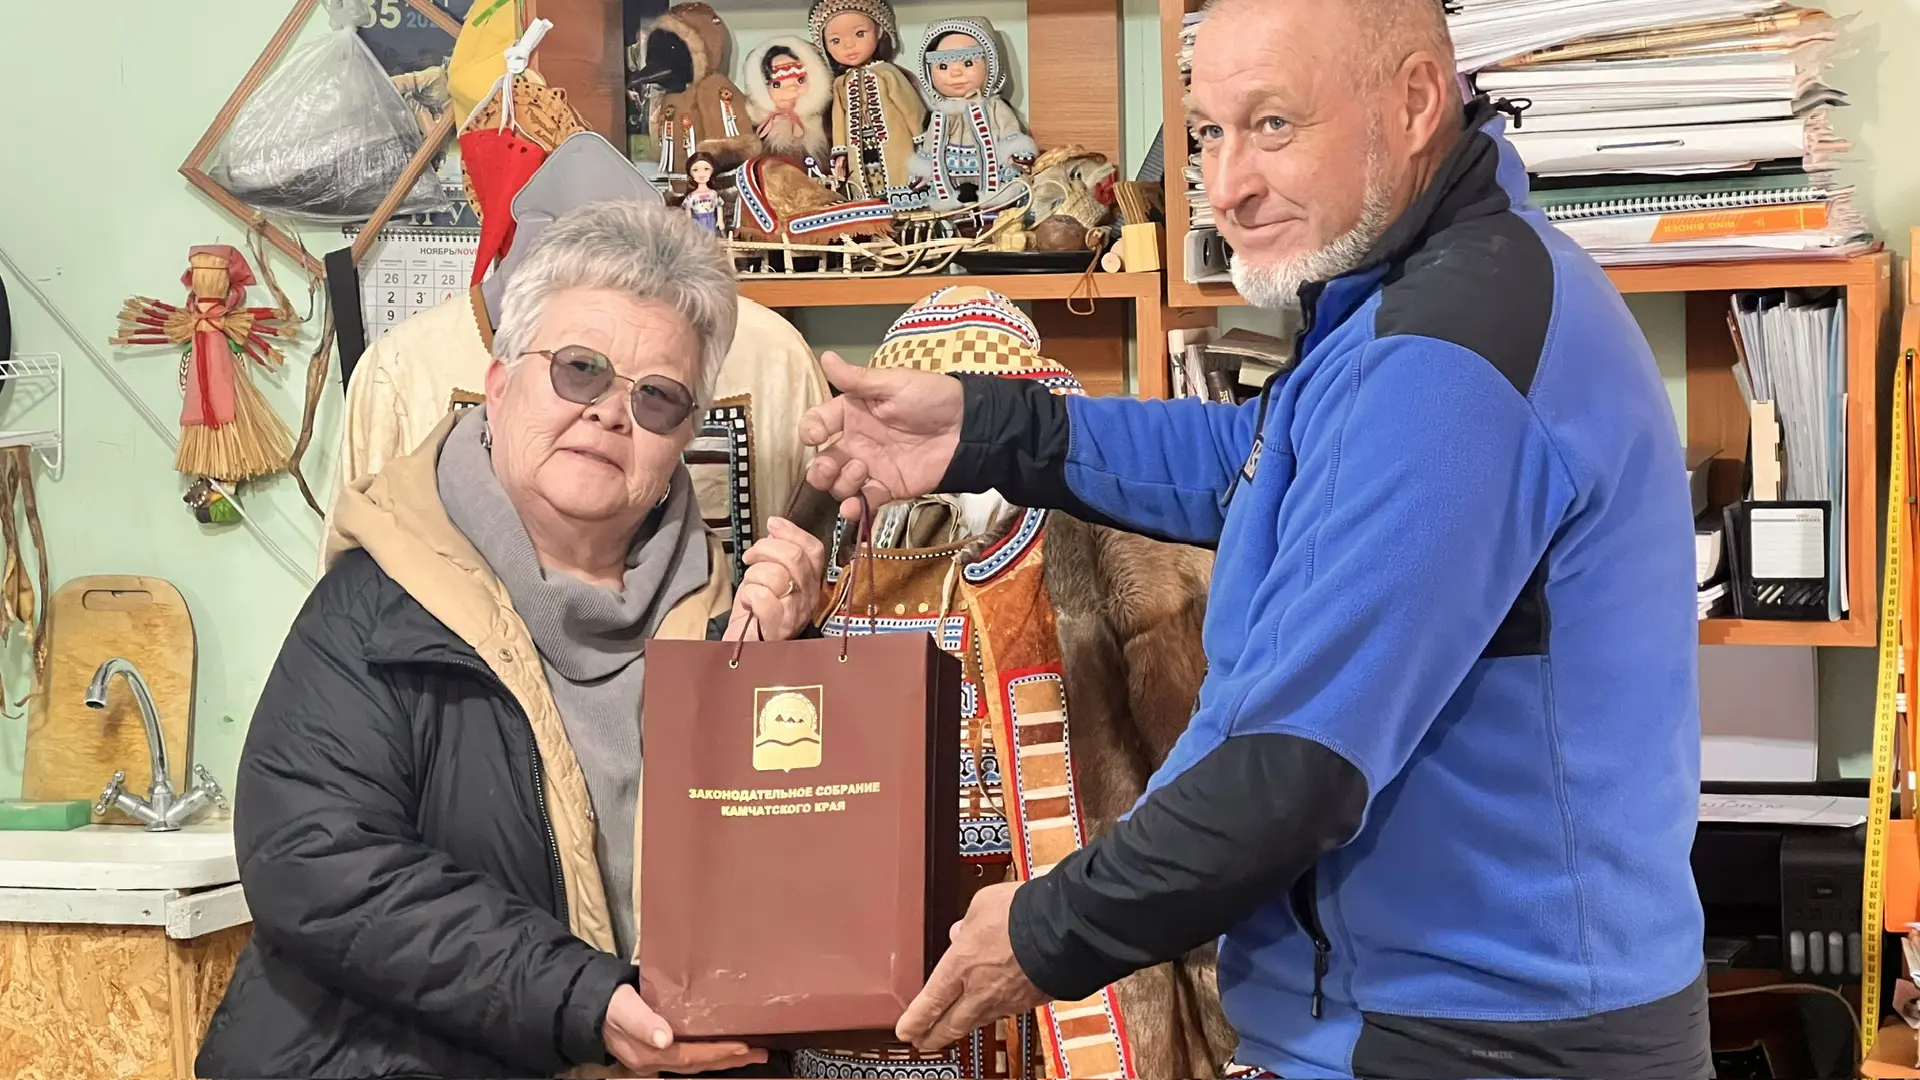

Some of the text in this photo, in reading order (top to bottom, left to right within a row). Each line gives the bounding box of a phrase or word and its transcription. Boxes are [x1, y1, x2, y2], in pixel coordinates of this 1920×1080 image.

[1663, 219, 1736, 234] RING BINDER
[420, 247, 478, 256] НОЯБРЬ/NOV
[384, 273, 455, 285] 26 27 28
[387, 291, 395, 304] 2
[387, 310, 395, 321] 9
[688, 781, 881, 802] ЗАКОНОДАТЕЛЬНОЕ СОБРАНИЕ
[721, 801, 846, 817] КАМЧАТСКОГО КРАЯ
